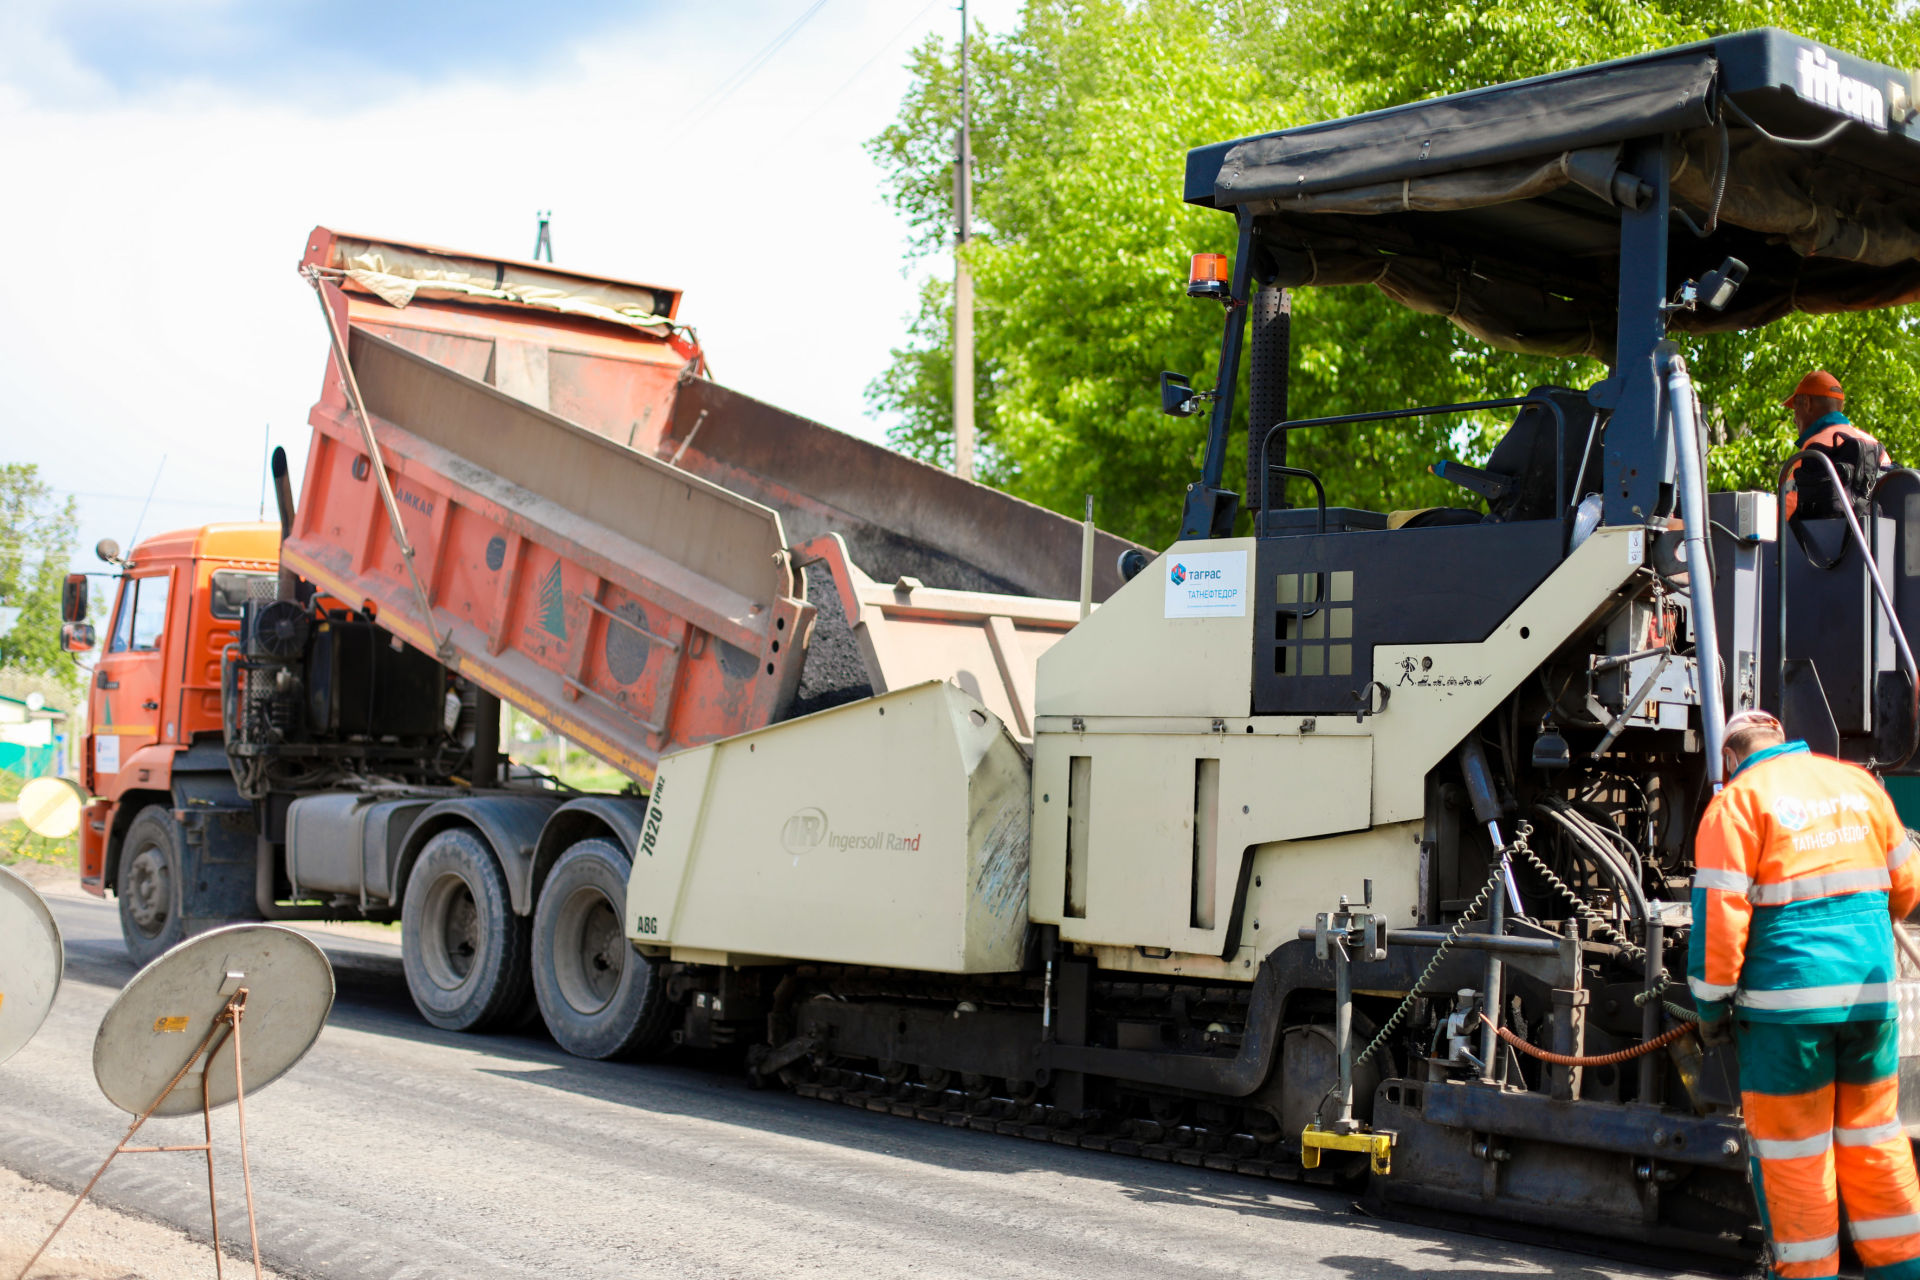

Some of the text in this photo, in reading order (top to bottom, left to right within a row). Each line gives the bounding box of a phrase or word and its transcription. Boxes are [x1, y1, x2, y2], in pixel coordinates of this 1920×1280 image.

[1797, 46, 1884, 129] titan
[1187, 589, 1238, 599] ТАТНЕФТЕДОР
[641, 806, 663, 857] 7820
[828, 831, 921, 853] Ingersoll Rand
[637, 916, 658, 935] ABG
